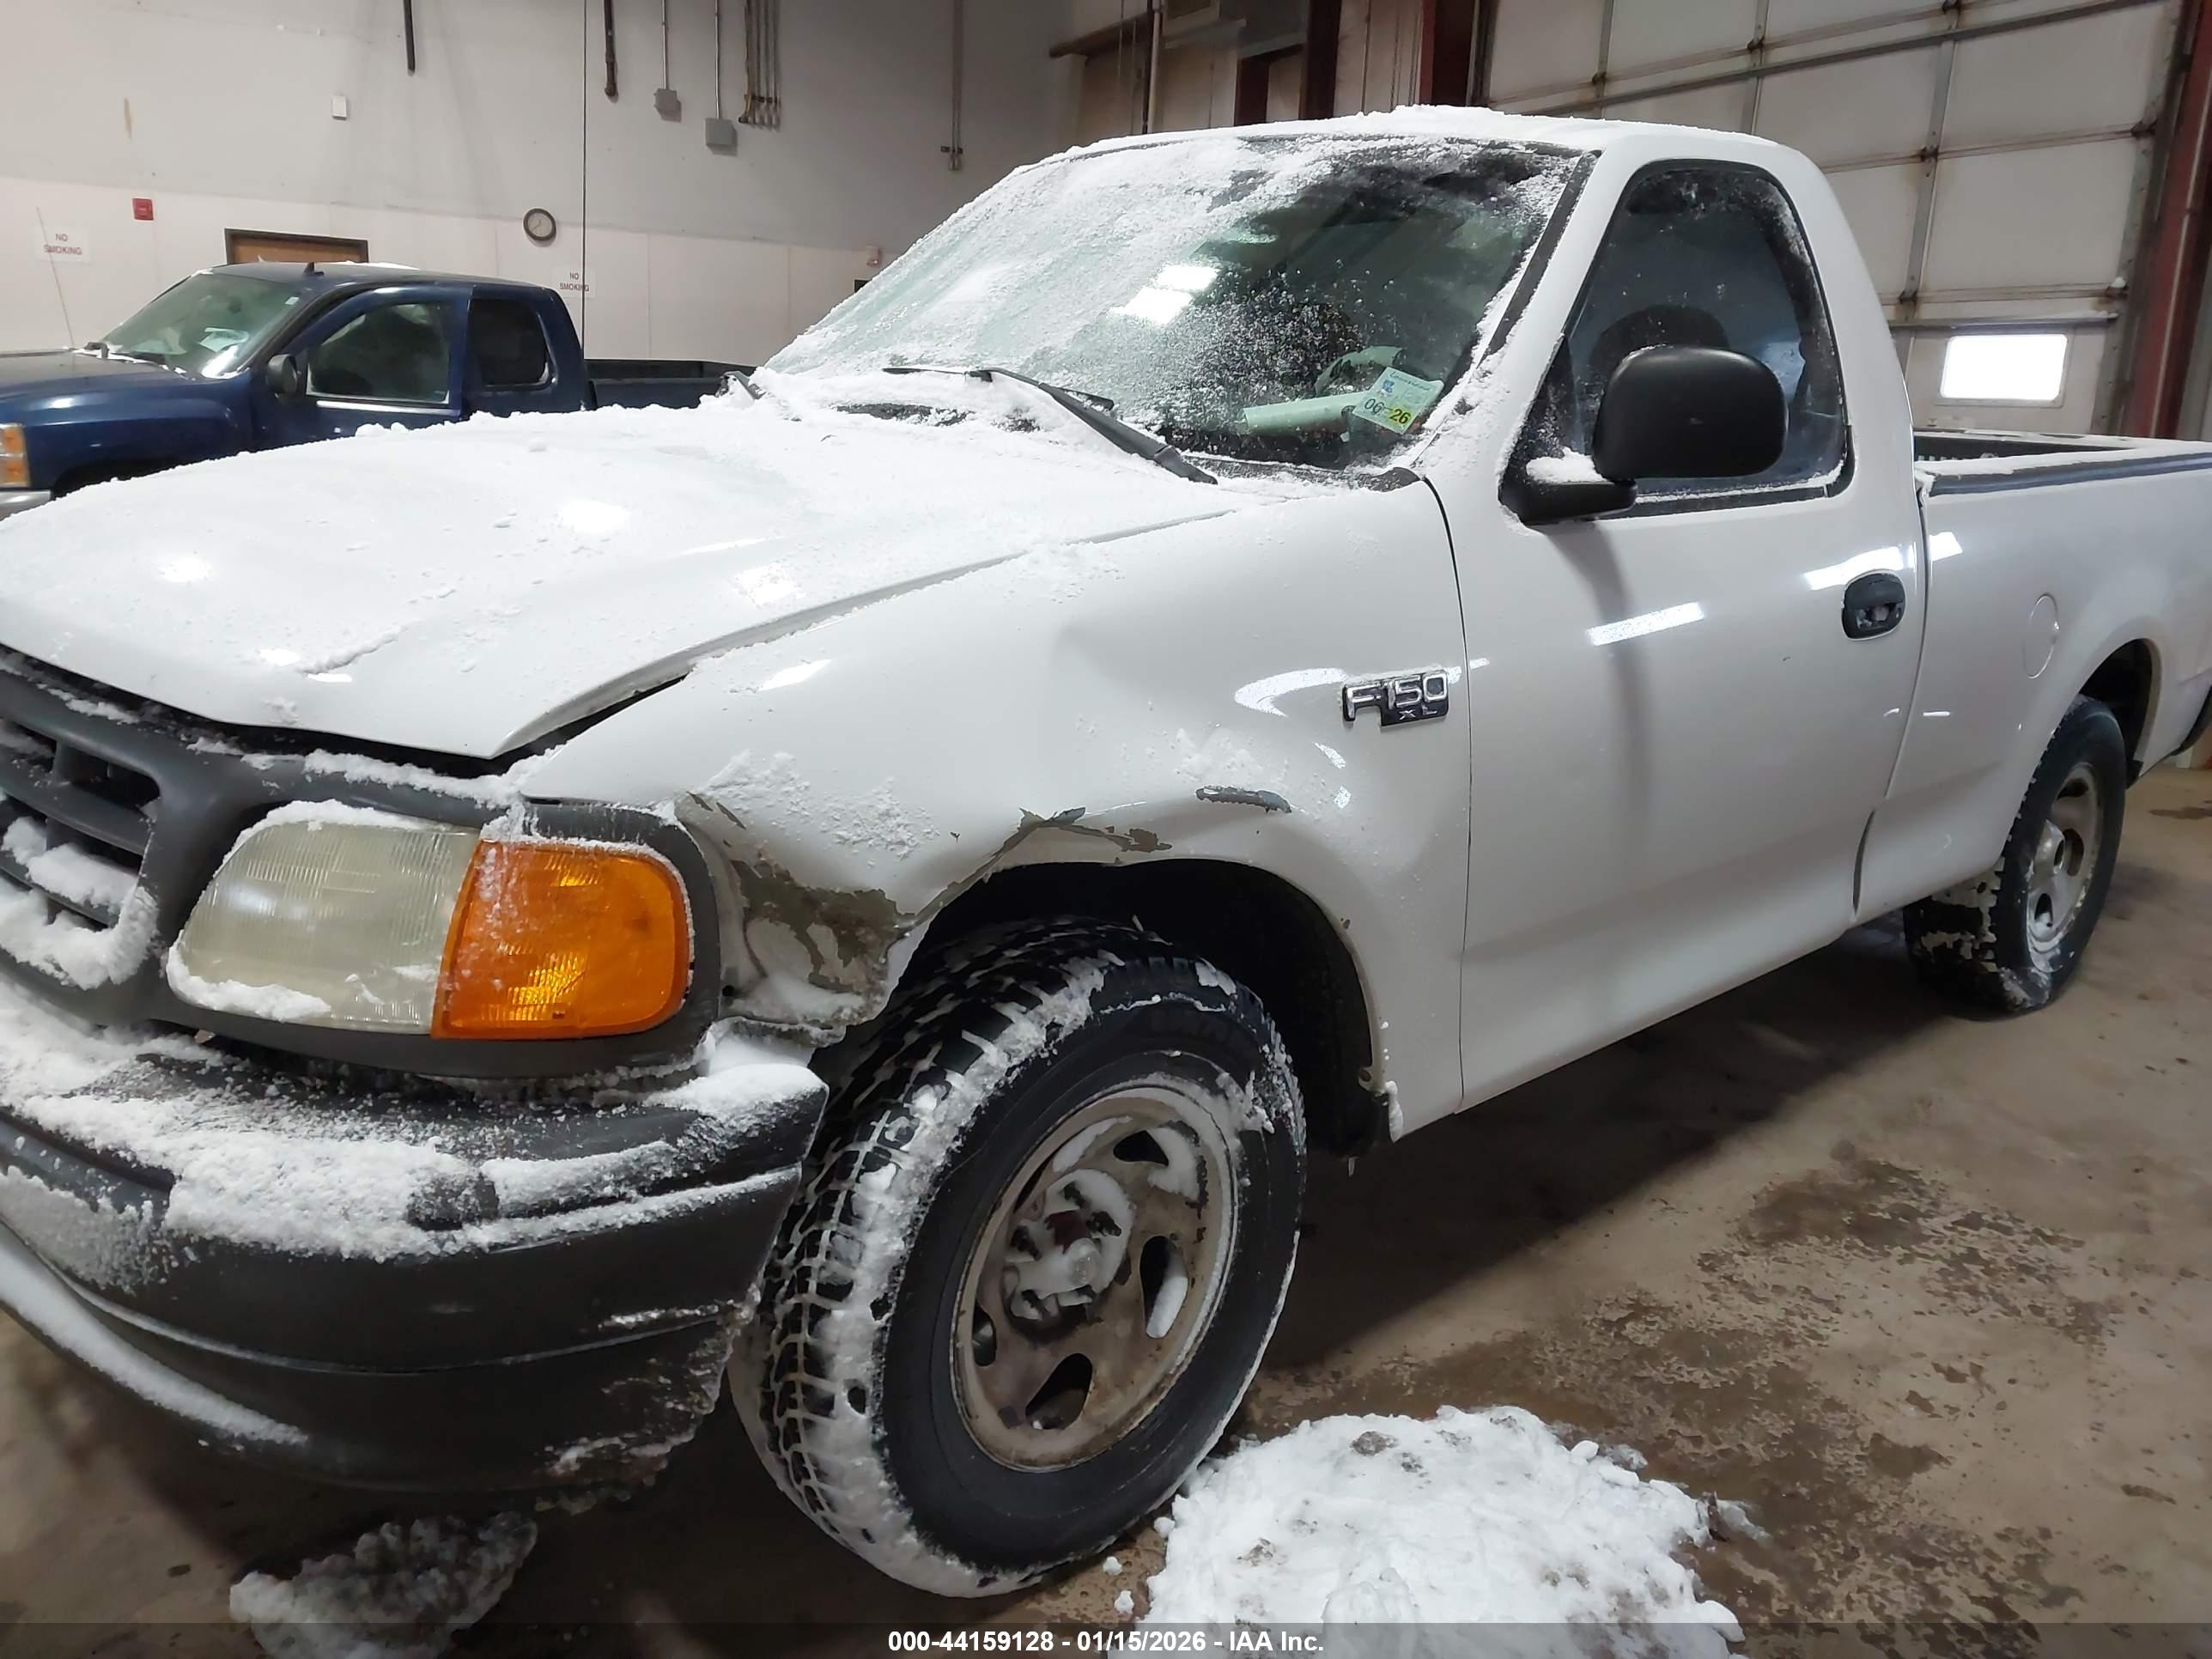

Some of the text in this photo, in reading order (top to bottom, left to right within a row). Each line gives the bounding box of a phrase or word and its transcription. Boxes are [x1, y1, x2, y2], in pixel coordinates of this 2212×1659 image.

[55, 233, 68, 242] NO
[44, 244, 82, 256] SMOKING
[569, 272, 580, 281] NO
[1398, 704, 1438, 720] XL
